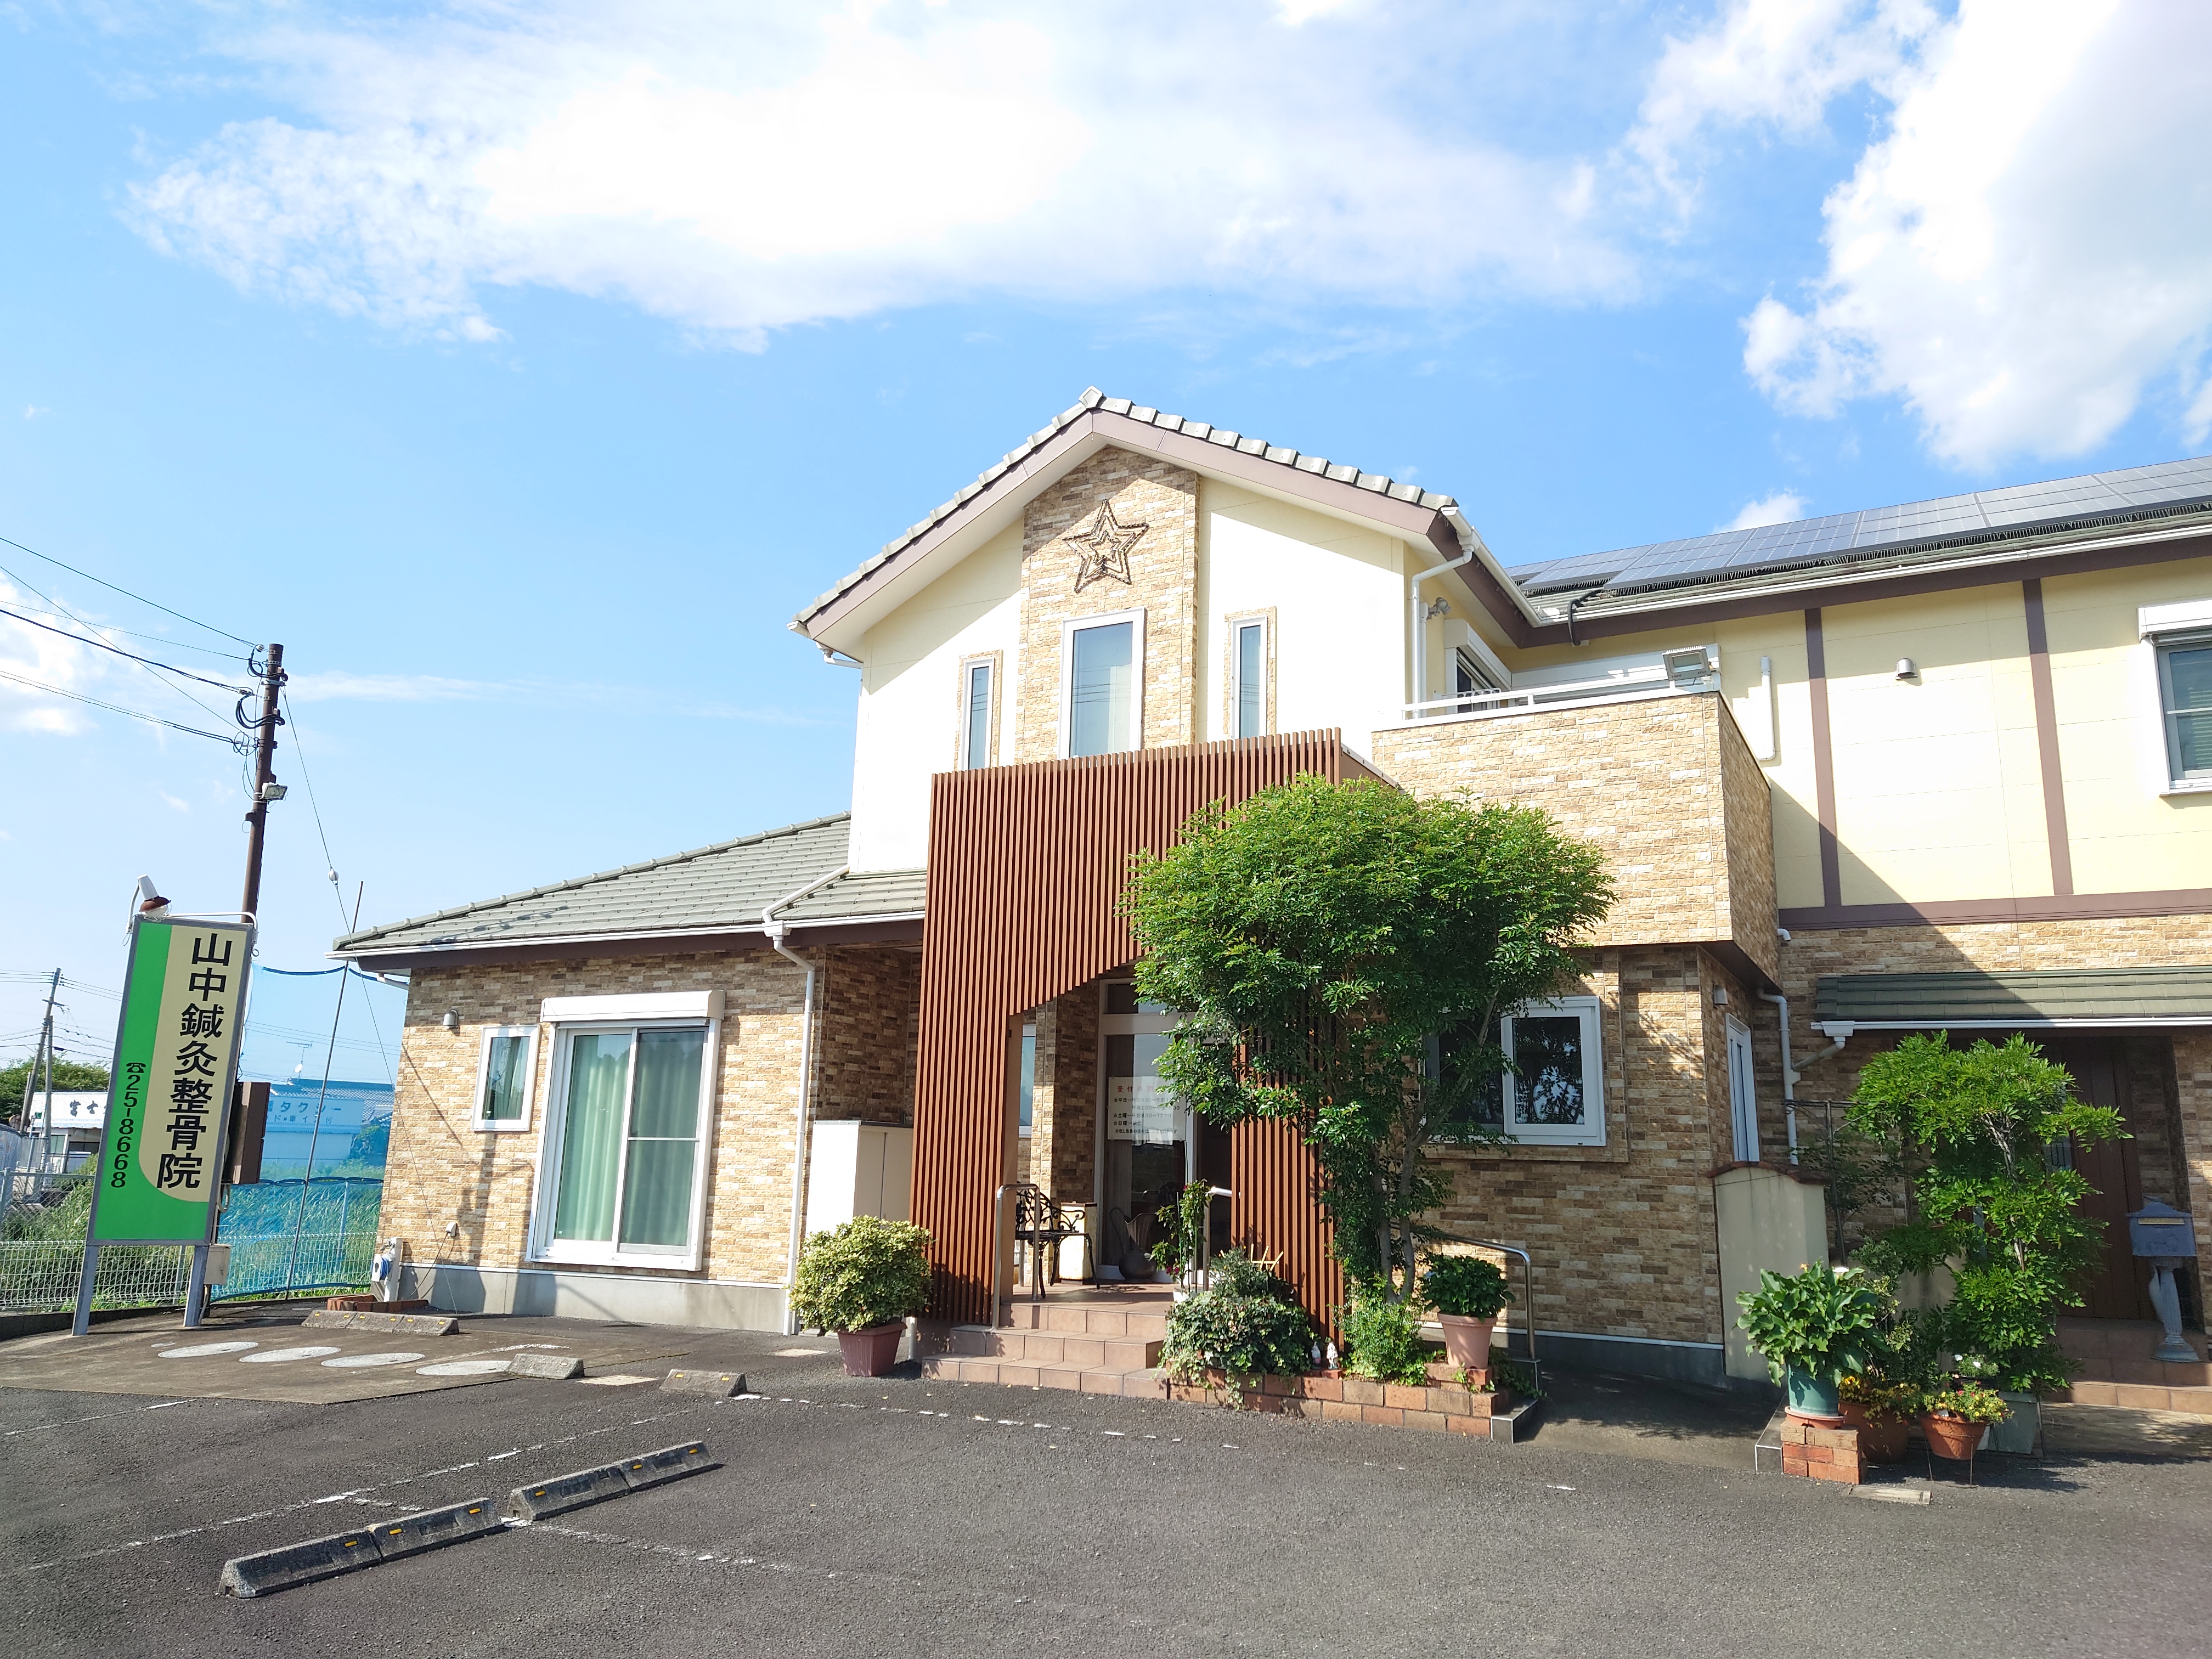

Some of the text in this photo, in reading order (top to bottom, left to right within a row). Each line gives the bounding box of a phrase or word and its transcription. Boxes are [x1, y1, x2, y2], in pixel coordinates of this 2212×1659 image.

[70, 1099, 106, 1117] 富士
[156, 933, 233, 1188] 山中鍼灸整骨院
